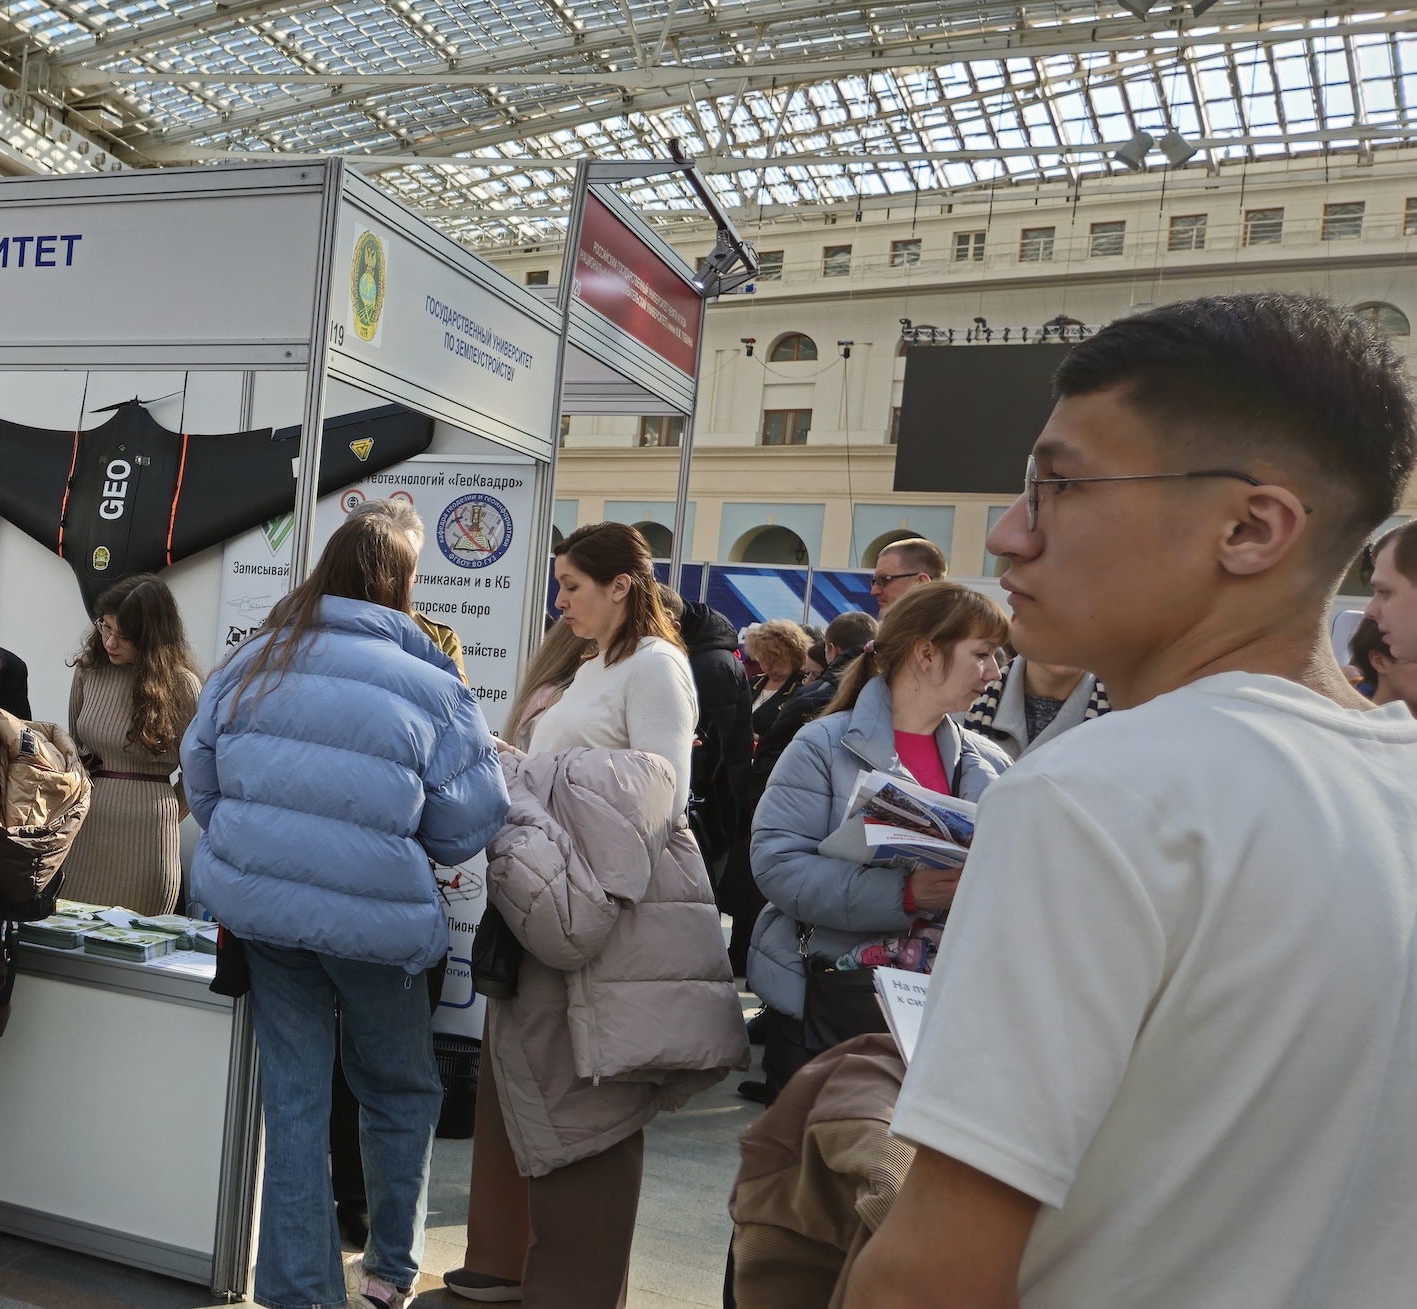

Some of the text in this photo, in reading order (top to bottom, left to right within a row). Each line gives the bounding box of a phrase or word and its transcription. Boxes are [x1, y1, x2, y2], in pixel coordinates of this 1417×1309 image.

[425, 295, 533, 370] ГОСУДАРСТВЕННЫЙ УНИВЕРСИТЕТ
[444, 331, 516, 382] ПО ЗЕМЛЕУСТРОЙСТВУ
[99, 460, 131, 520] GEO
[448, 473, 523, 491] «ГеоКвадро»
[414, 574, 511, 589] отникакам и в КБ
[461, 601, 491, 618] бюро
[462, 642, 507, 658] зяйстве
[470, 685, 507, 702] сфере
[446, 967, 470, 979] огии
[892, 980, 928, 996] На пу
